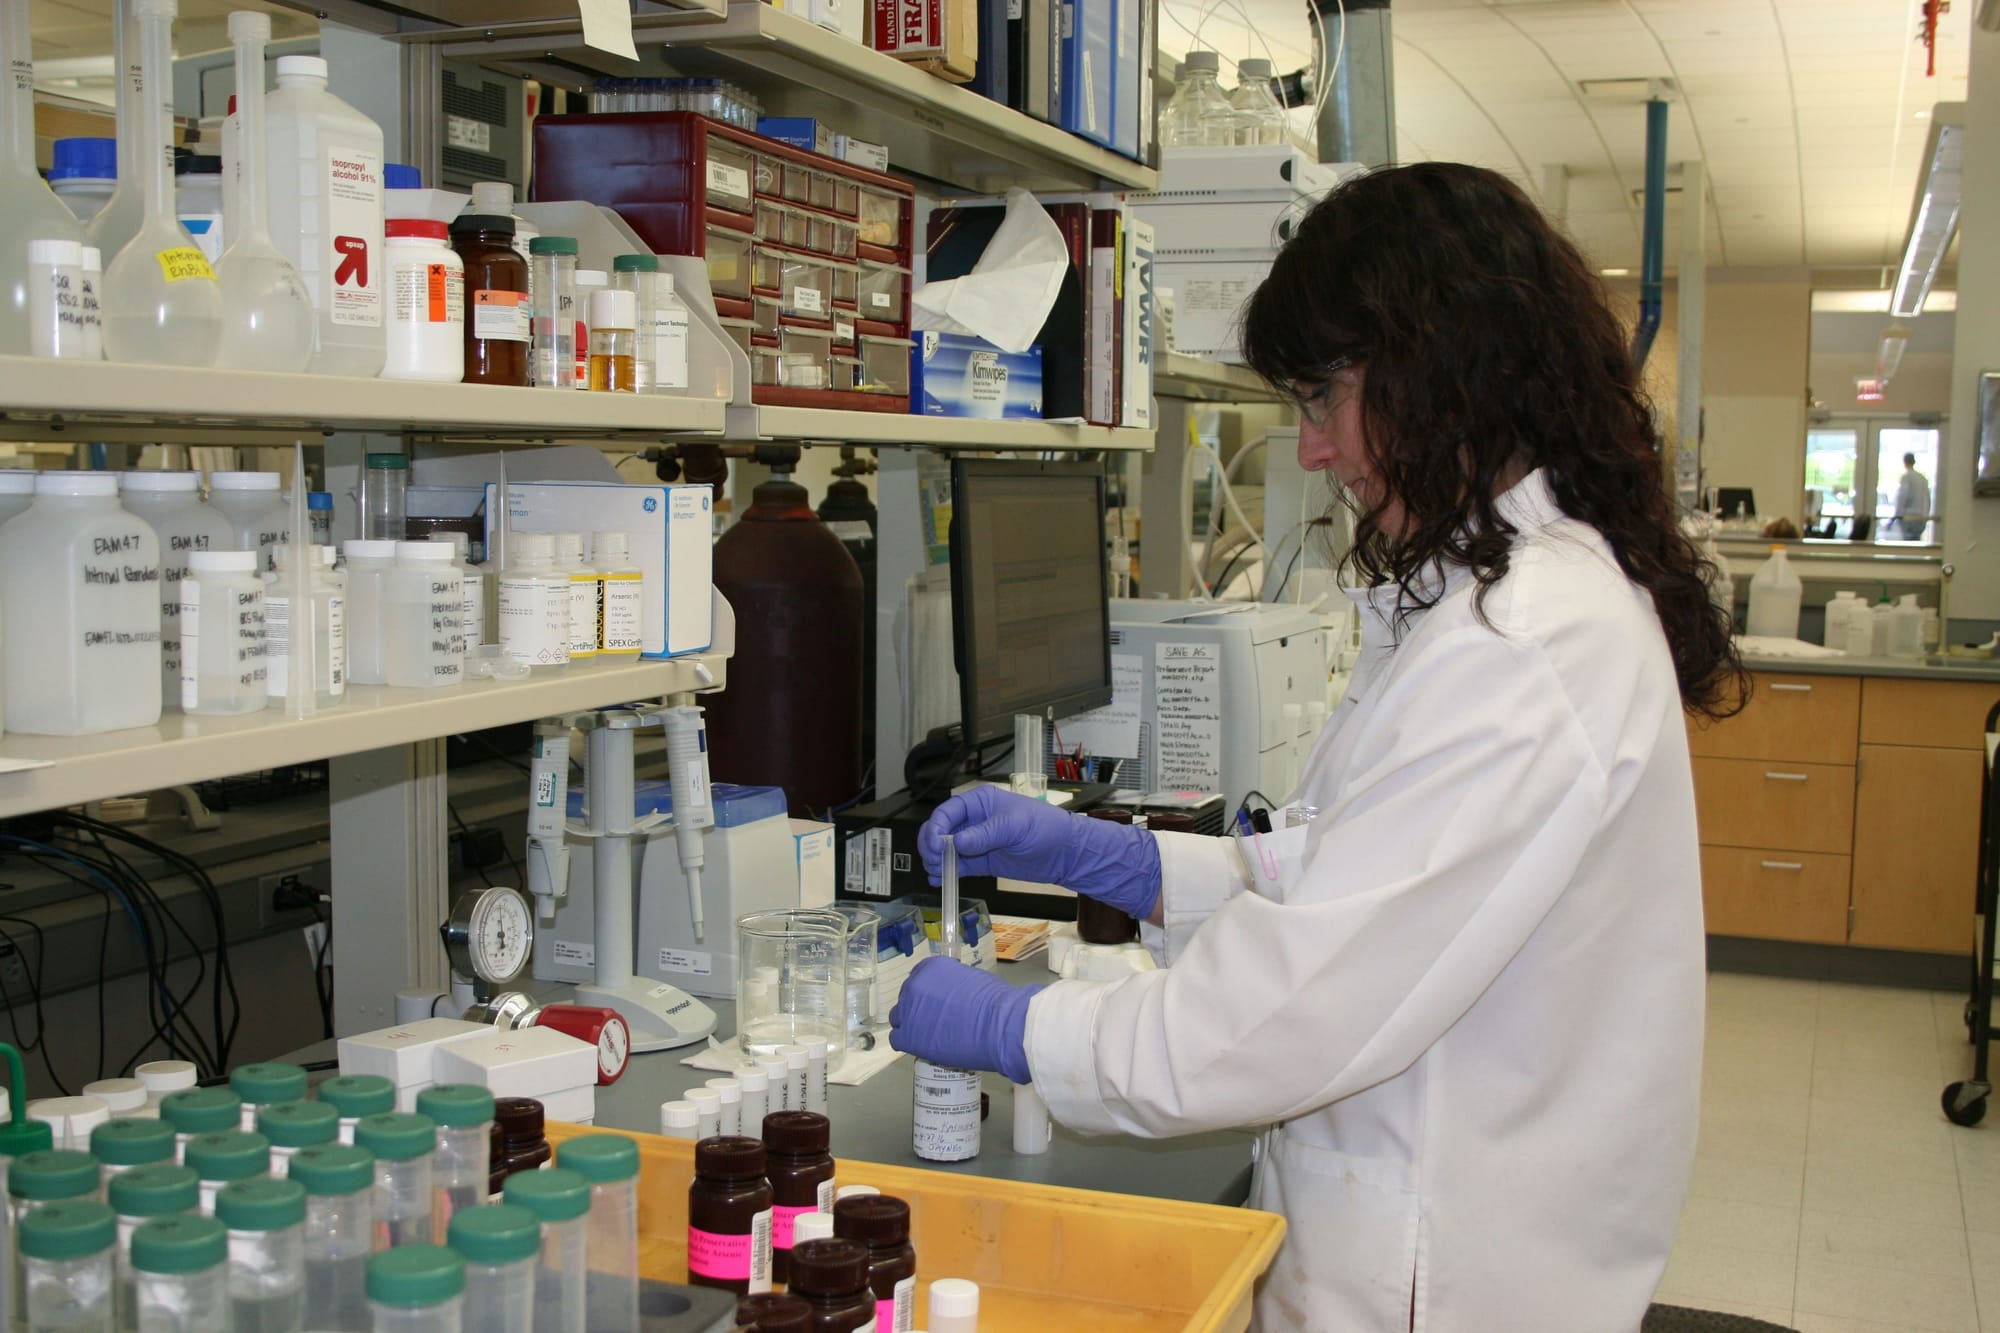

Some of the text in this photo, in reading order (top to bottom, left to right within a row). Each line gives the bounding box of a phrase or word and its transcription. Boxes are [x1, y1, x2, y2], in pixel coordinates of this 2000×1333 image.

[332, 158, 366, 172] isopropyl
[332, 169, 376, 184] alcohol 91%
[972, 360, 1006, 384] Kimwipes
[608, 639, 626, 648] SPEX
[1166, 646, 1206, 657] SAVE AS
